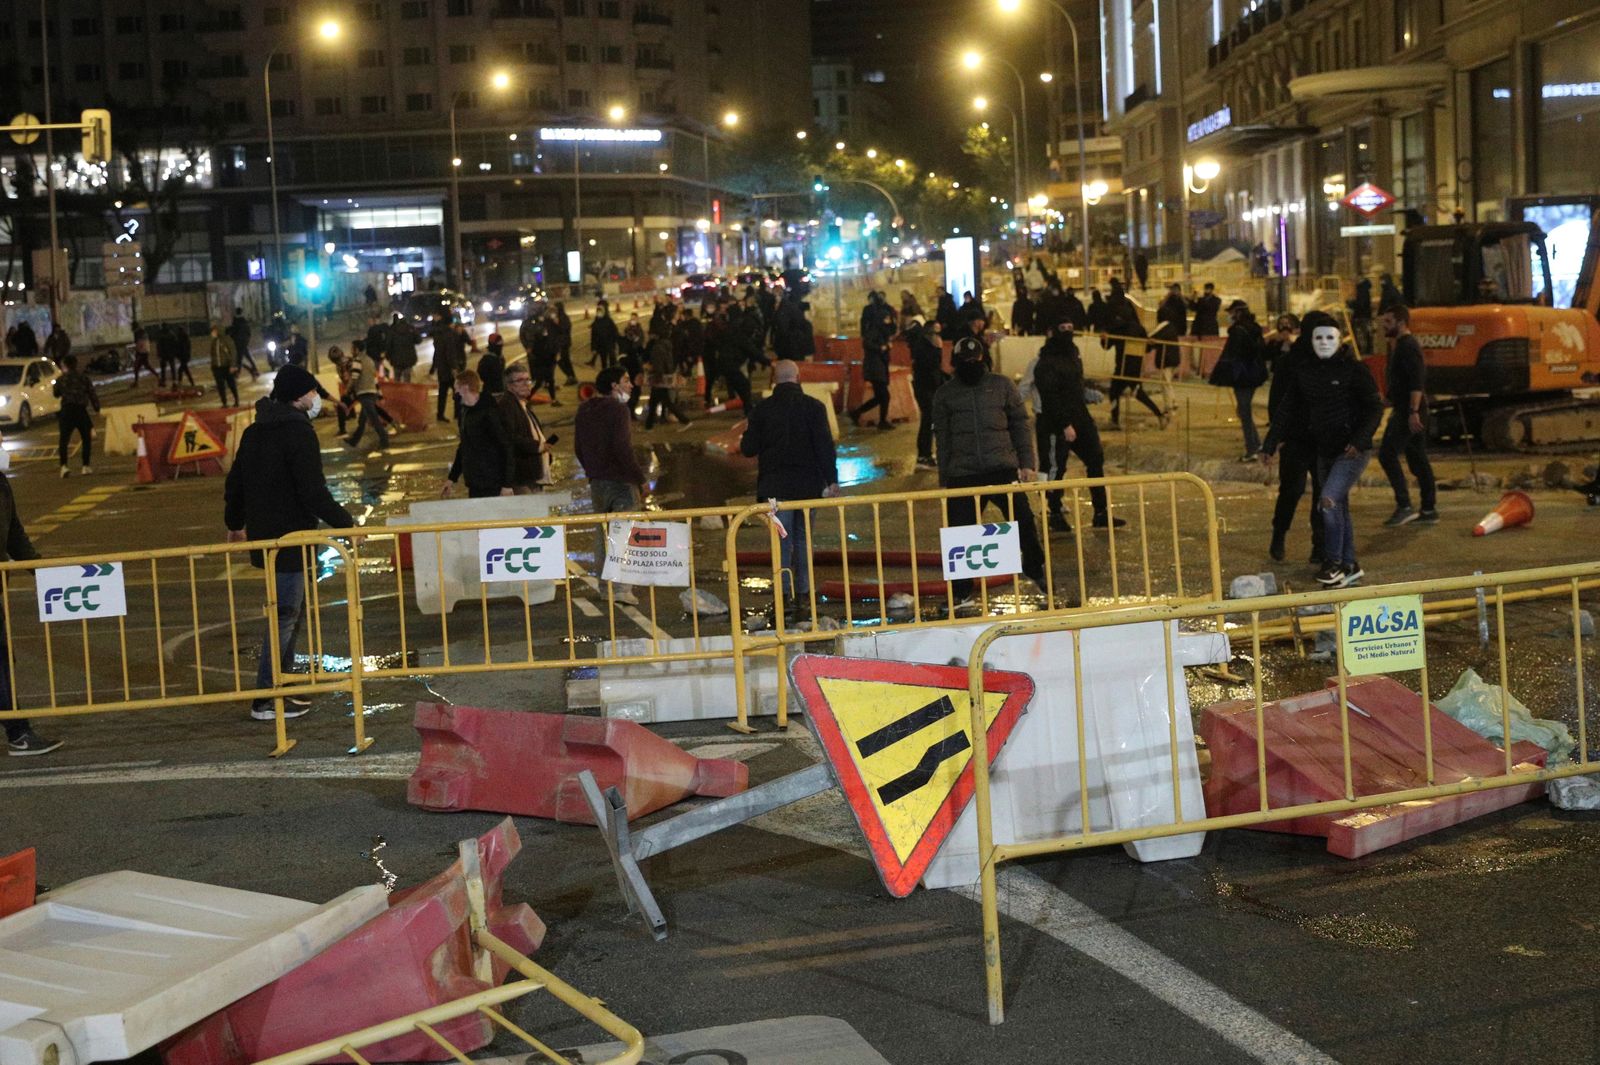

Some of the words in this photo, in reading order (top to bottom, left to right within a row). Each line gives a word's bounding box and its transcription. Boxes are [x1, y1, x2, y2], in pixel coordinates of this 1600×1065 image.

[1413, 335, 1457, 348] OSAN
[486, 547, 541, 574] FCC
[632, 560, 654, 568] PLAZA
[655, 559, 683, 568] ESPAÑA
[947, 543, 999, 573] FCC
[44, 584, 101, 614] FCC
[1348, 610, 1418, 637] PACSA
[1354, 644, 1383, 653] Servicios
[1385, 641, 1412, 649] Urbanos
[1370, 650, 1389, 659] Medio
[1391, 648, 1416, 656] Natural
